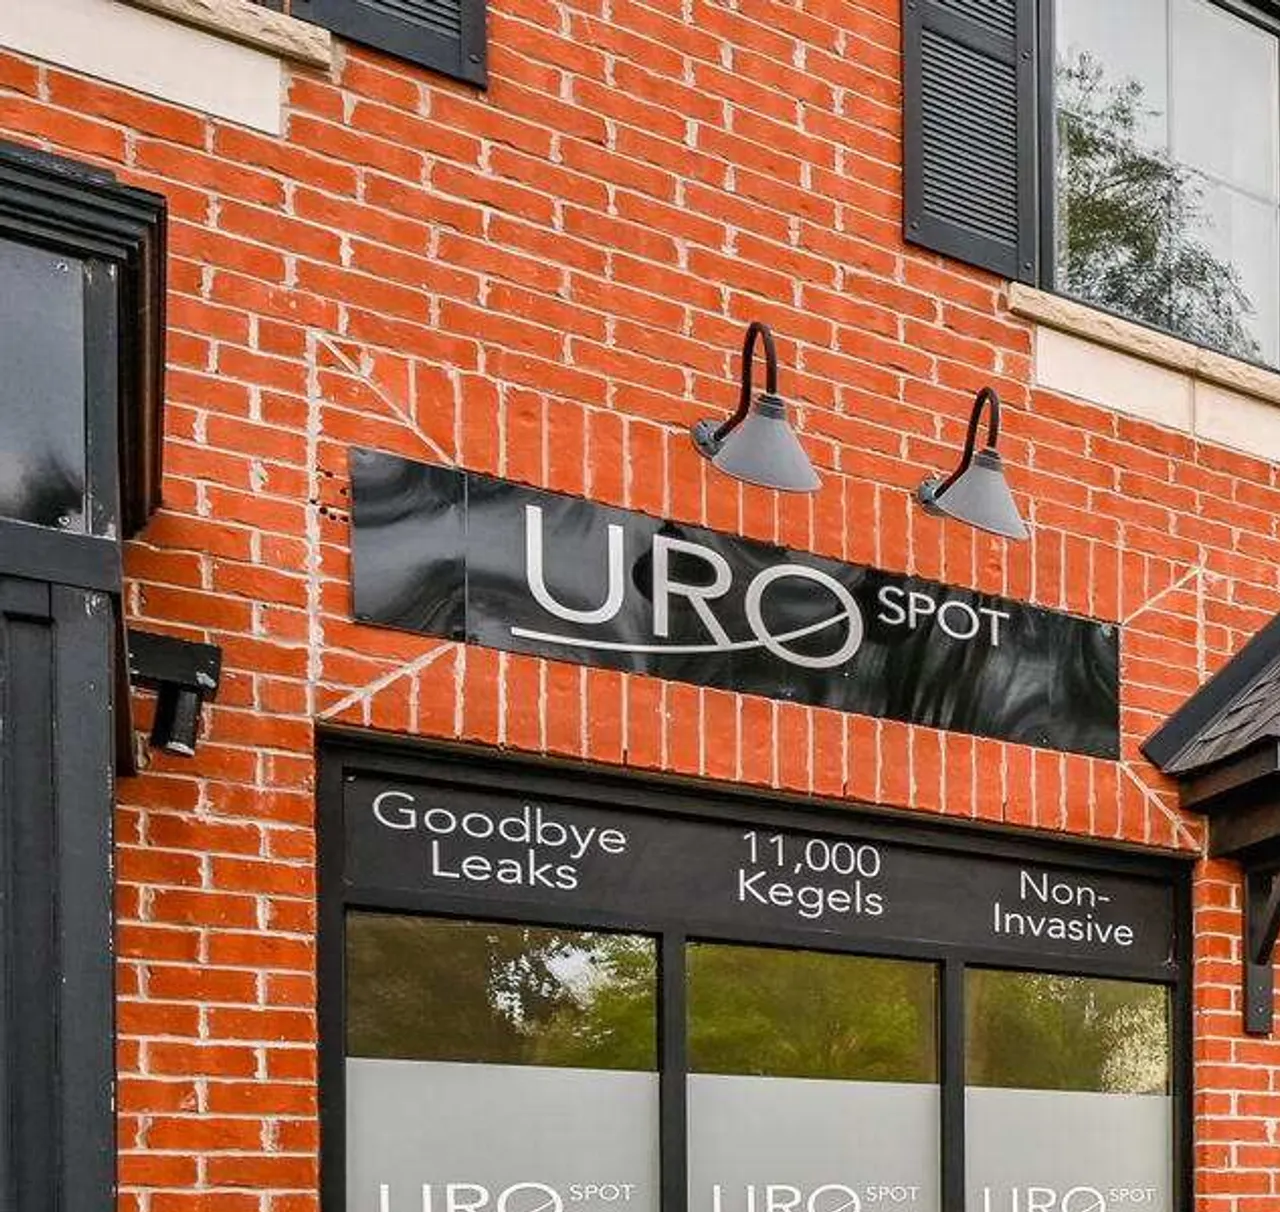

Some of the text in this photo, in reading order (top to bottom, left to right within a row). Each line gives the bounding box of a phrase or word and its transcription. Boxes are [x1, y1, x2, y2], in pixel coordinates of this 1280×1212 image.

[522, 503, 1011, 669] URO SPOT
[371, 790, 628, 861] Goodbye
[431, 838, 579, 891] Leaks
[742, 830, 882, 879] 11,000
[737, 867, 885, 920] Kegels
[1019, 869, 1111, 909] Non-
[993, 901, 1135, 947] Invasive
[569, 1182, 635, 1202] SPOT
[866, 1185, 920, 1202] SPOT
[1109, 1187, 1157, 1202] SPOT
